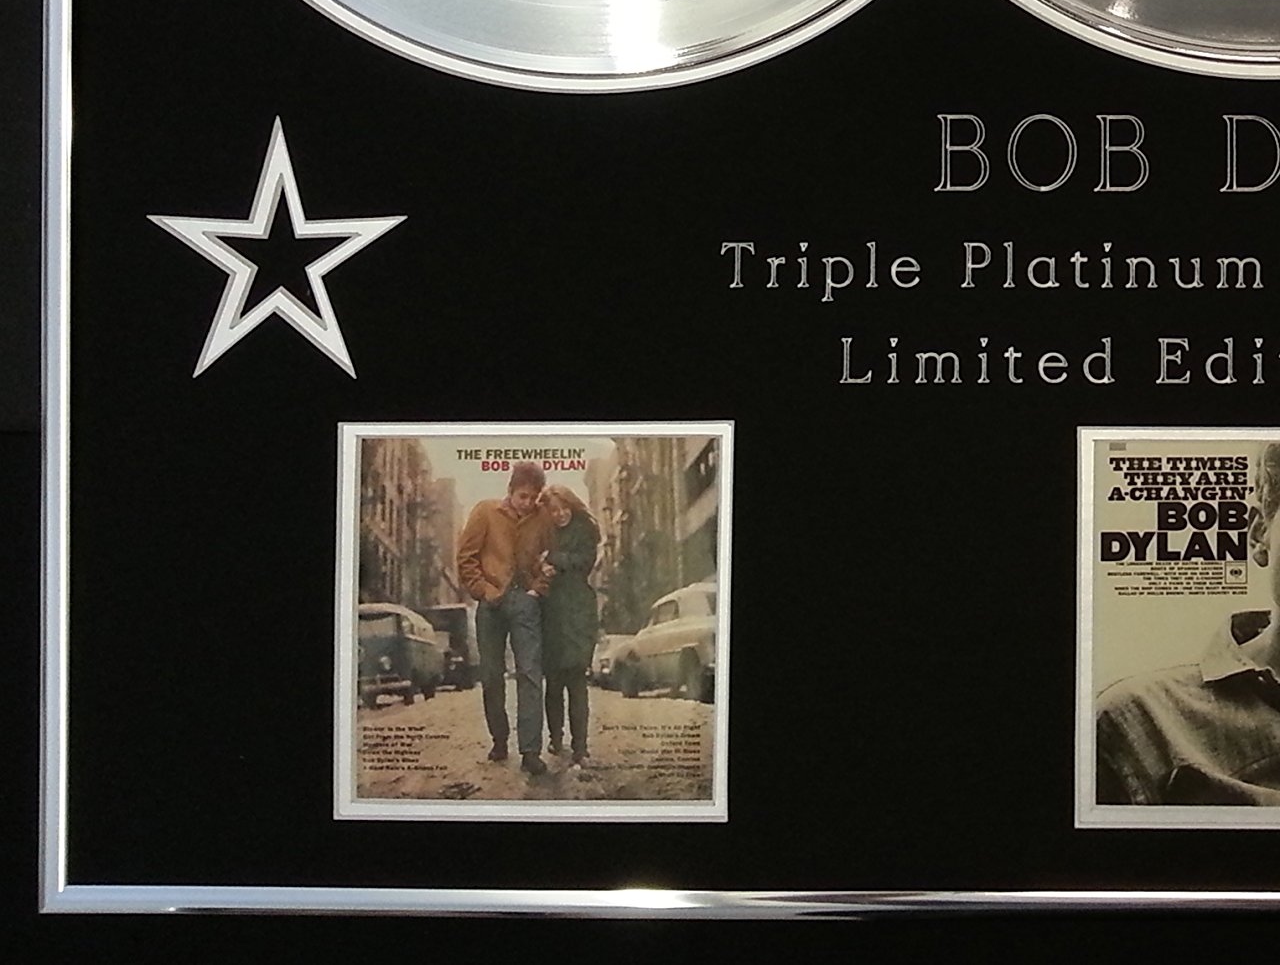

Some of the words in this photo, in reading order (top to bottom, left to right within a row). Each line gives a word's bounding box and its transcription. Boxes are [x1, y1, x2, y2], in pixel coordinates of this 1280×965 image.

[933, 113, 1150, 193] BOB
[720, 241, 921, 303] Triple
[960, 241, 1264, 290] Platinum
[839, 336, 1116, 385] Limited
[456, 449, 482, 460] THE
[485, 448, 585, 459] FREEWHEELIN'
[1109, 457, 1162, 471] THE
[1166, 456, 1249, 471] TIMES
[481, 460, 510, 471] BOB
[543, 460, 586, 470] DYLAN
[1124, 472, 1194, 486] THEY
[1196, 472, 1248, 486] ARE
[1108, 486, 1254, 501] A-CHANGIN'
[1157, 501, 1249, 531] BOB
[1100, 531, 1248, 561] DYLAN
